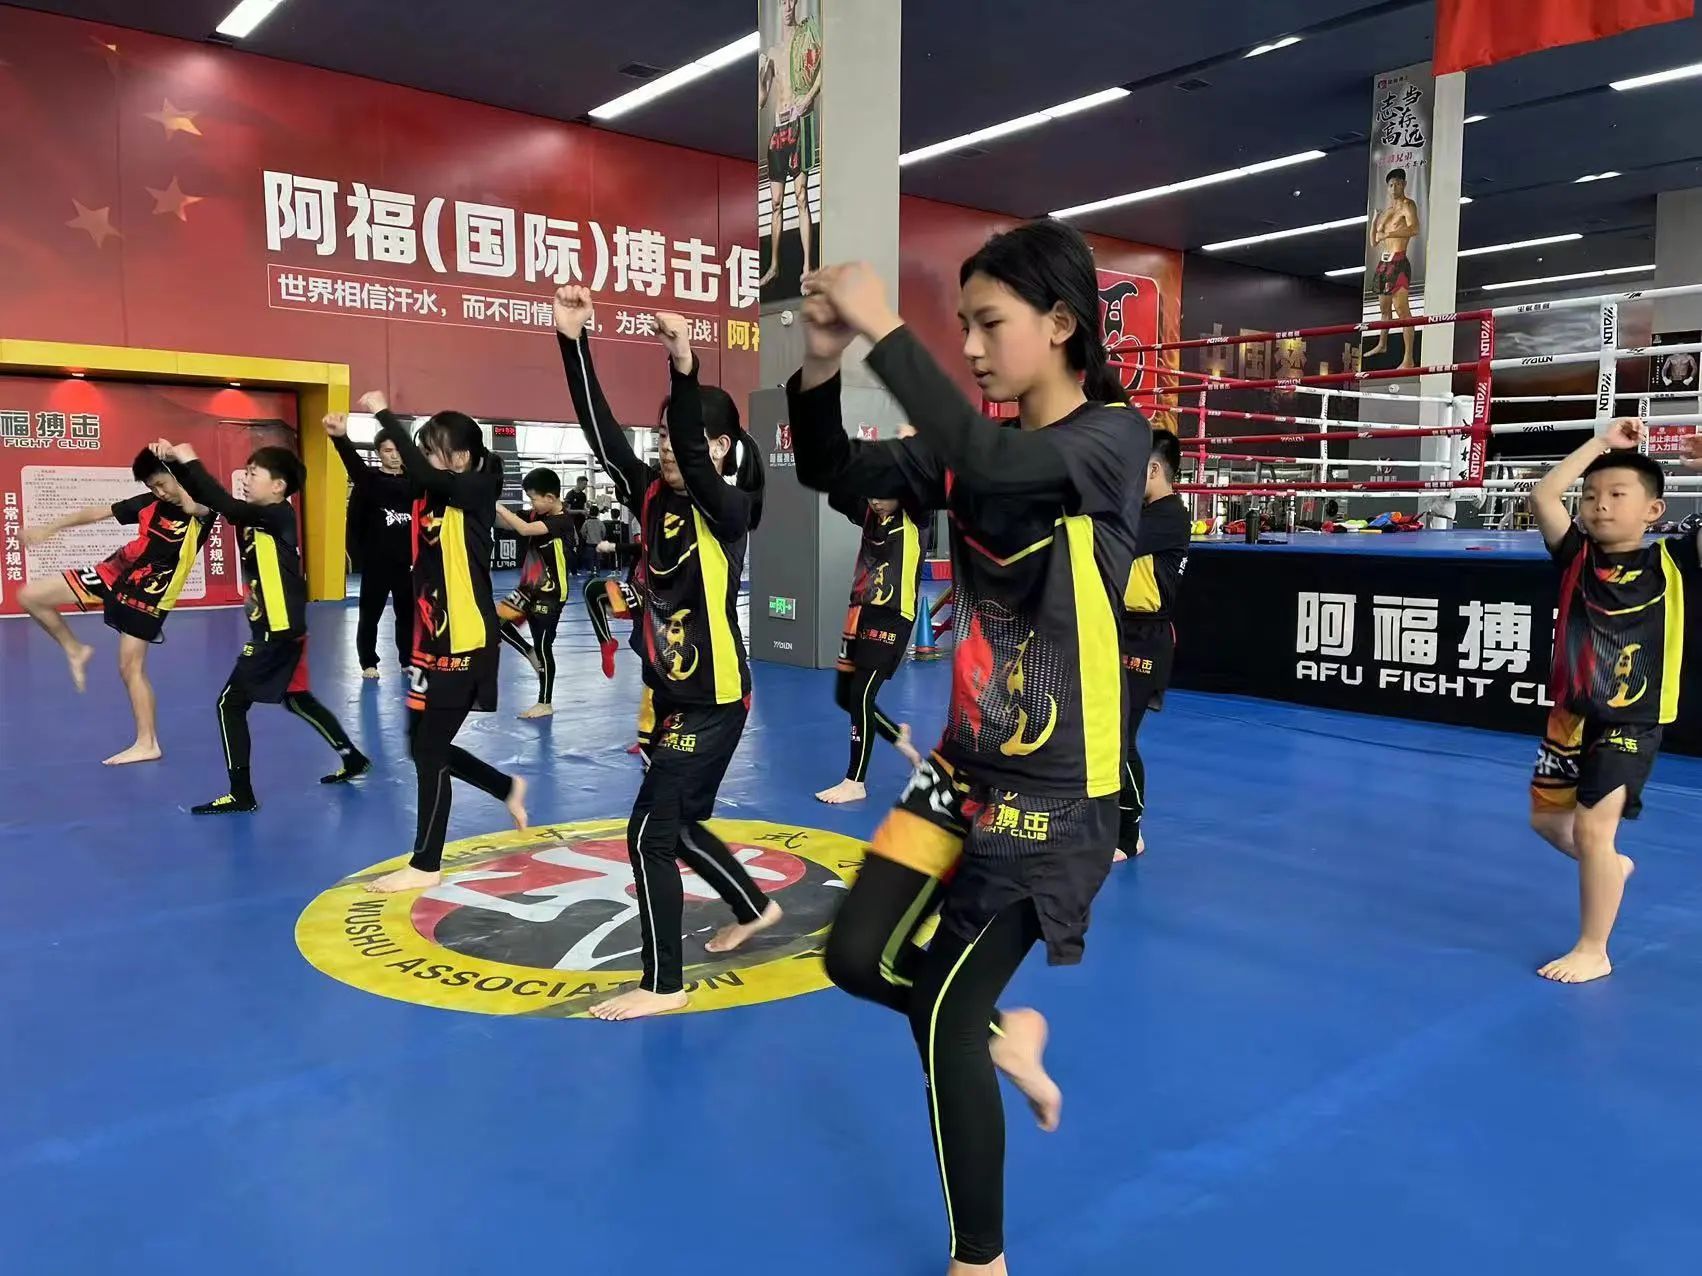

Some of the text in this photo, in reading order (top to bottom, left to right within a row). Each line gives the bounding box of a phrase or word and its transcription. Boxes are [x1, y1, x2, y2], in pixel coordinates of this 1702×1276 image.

[263, 170, 759, 309] 阿福(国际)搏击俱
[278, 272, 718, 342] 世界相信汗水，而不同情，为荣战！
[4, 438, 101, 450] FIGHT CLUB
[4, 493, 23, 580] 日常行为规范
[209, 513, 225, 575] 行为规范
[1297, 592, 1558, 673] 阿福搏
[1296, 660, 1555, 706] AFU FIGHT CL
[1010, 828, 1047, 841] CLUB
[345, 899, 744, 998] WUSHU ASSOCIATN
